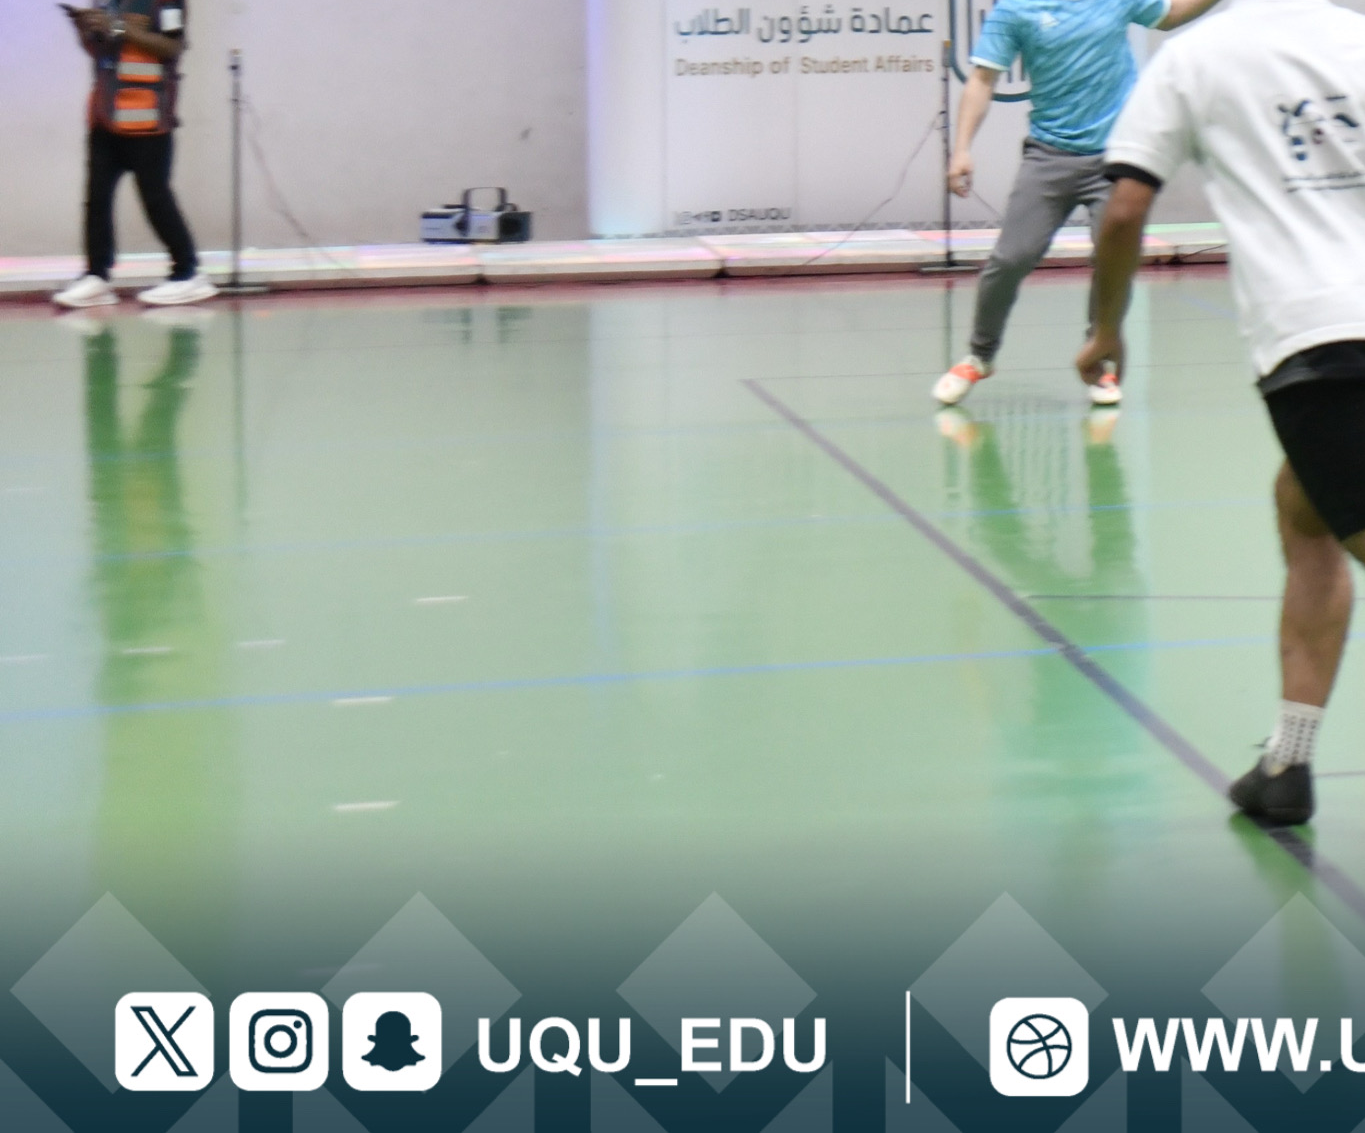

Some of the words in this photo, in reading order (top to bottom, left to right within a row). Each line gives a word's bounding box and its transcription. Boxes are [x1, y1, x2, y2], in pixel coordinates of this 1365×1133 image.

[674, 8, 751, 44] الطلاب
[757, 4, 842, 43] شؤون
[850, 7, 934, 34] عمادة
[674, 58, 765, 78] Deanship
[769, 56, 792, 75] of
[800, 55, 869, 75] Student
[874, 55, 936, 74] Affairs
